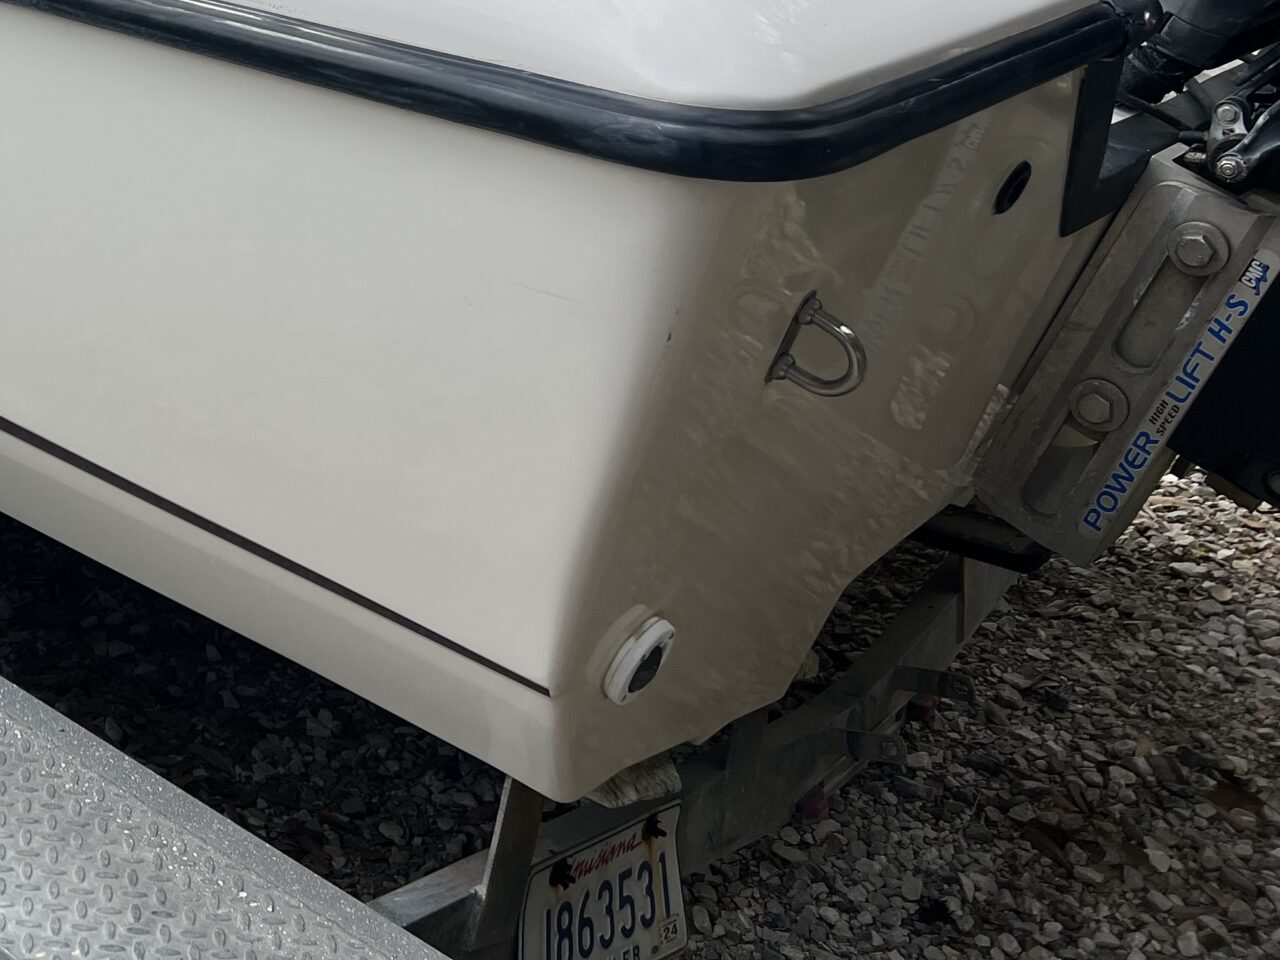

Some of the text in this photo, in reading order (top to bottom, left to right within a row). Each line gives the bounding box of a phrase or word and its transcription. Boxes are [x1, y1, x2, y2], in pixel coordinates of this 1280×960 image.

[1242, 260, 1268, 288] CMC
[1082, 293, 1250, 534] POWER LIFT H-S
[1149, 399, 1169, 426] HIGH
[1156, 404, 1180, 436] SPEED
[572, 832, 642, 881] ouisiana
[663, 923, 678, 940] 24
